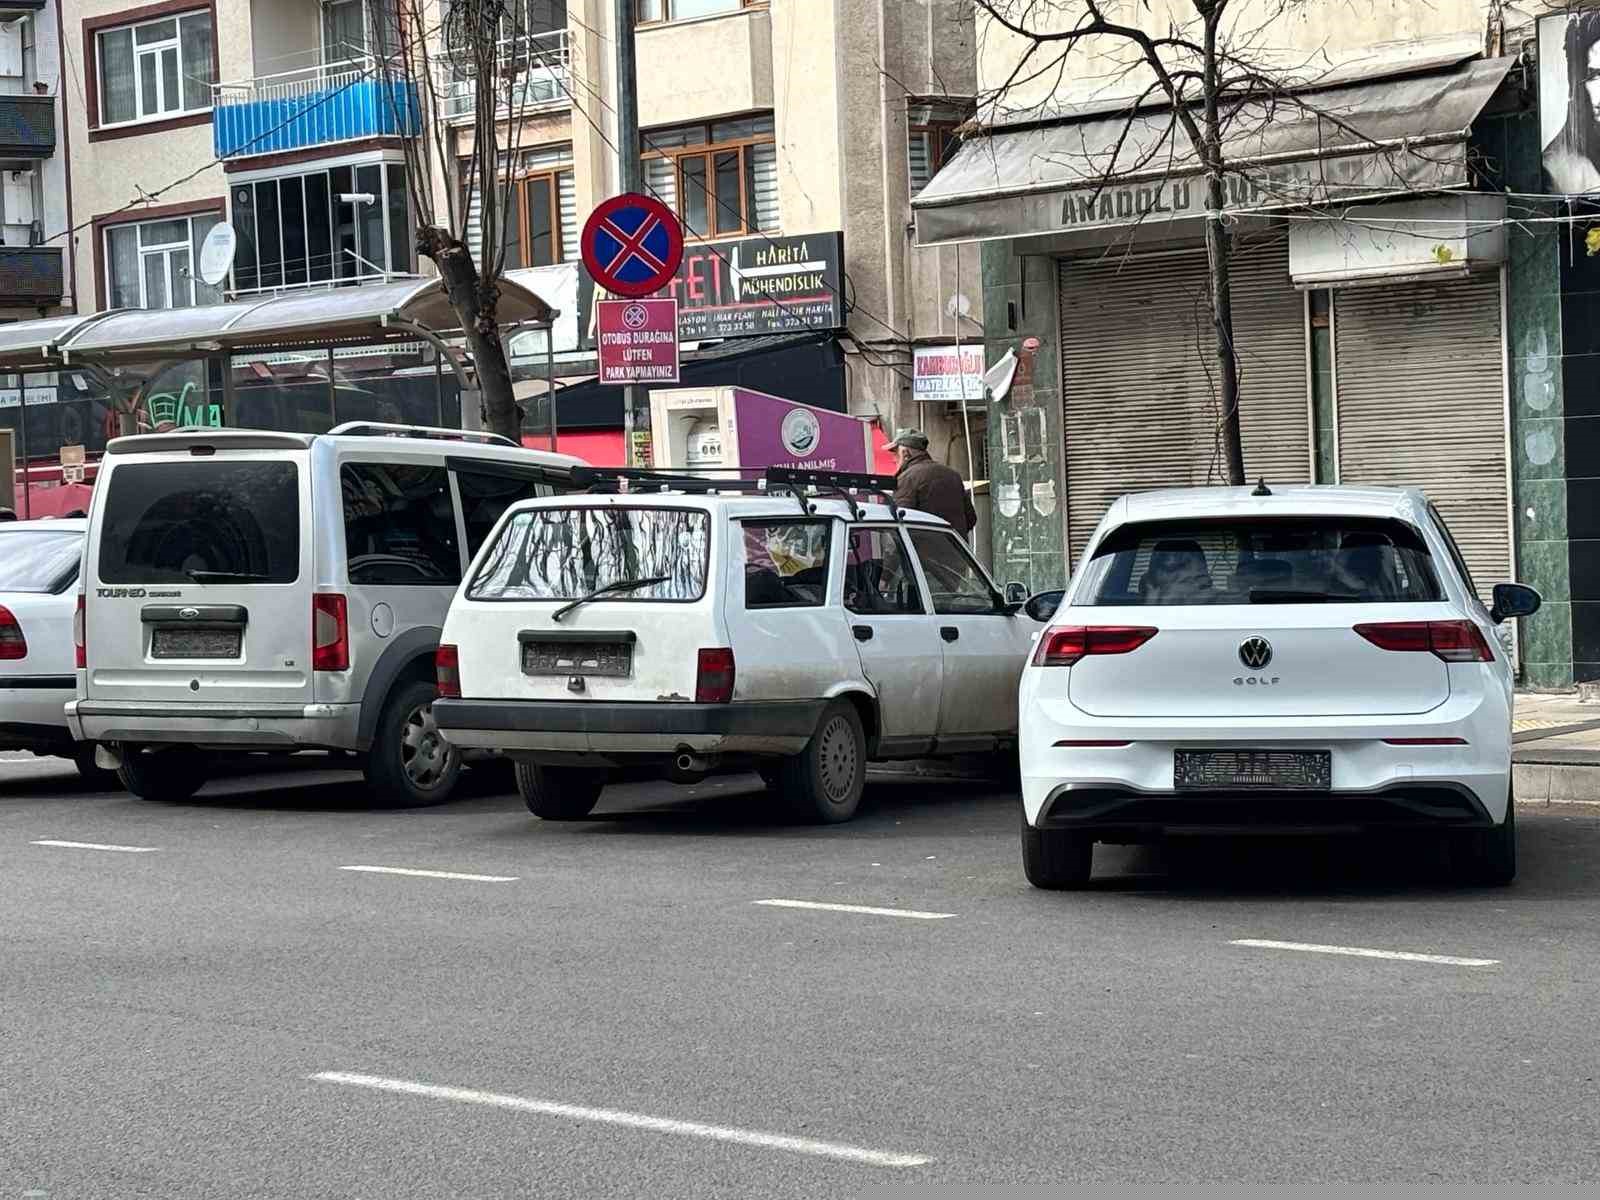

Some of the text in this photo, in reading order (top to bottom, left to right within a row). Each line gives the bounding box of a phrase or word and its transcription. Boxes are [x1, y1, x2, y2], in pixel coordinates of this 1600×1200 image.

[1061, 182, 1190, 225] ANADOLU
[756, 241, 809, 266] HARİTA
[741, 273, 824, 296] MÜHENDİSLİK
[602, 329, 674, 345] OTOBÜS DURAĞINA
[622, 347, 653, 362] LÜTFEN
[606, 365, 673, 379] PARK YAPMAYINIZ
[184, 404, 223, 428] MA
[1232, 677, 1281, 686] GOLF
